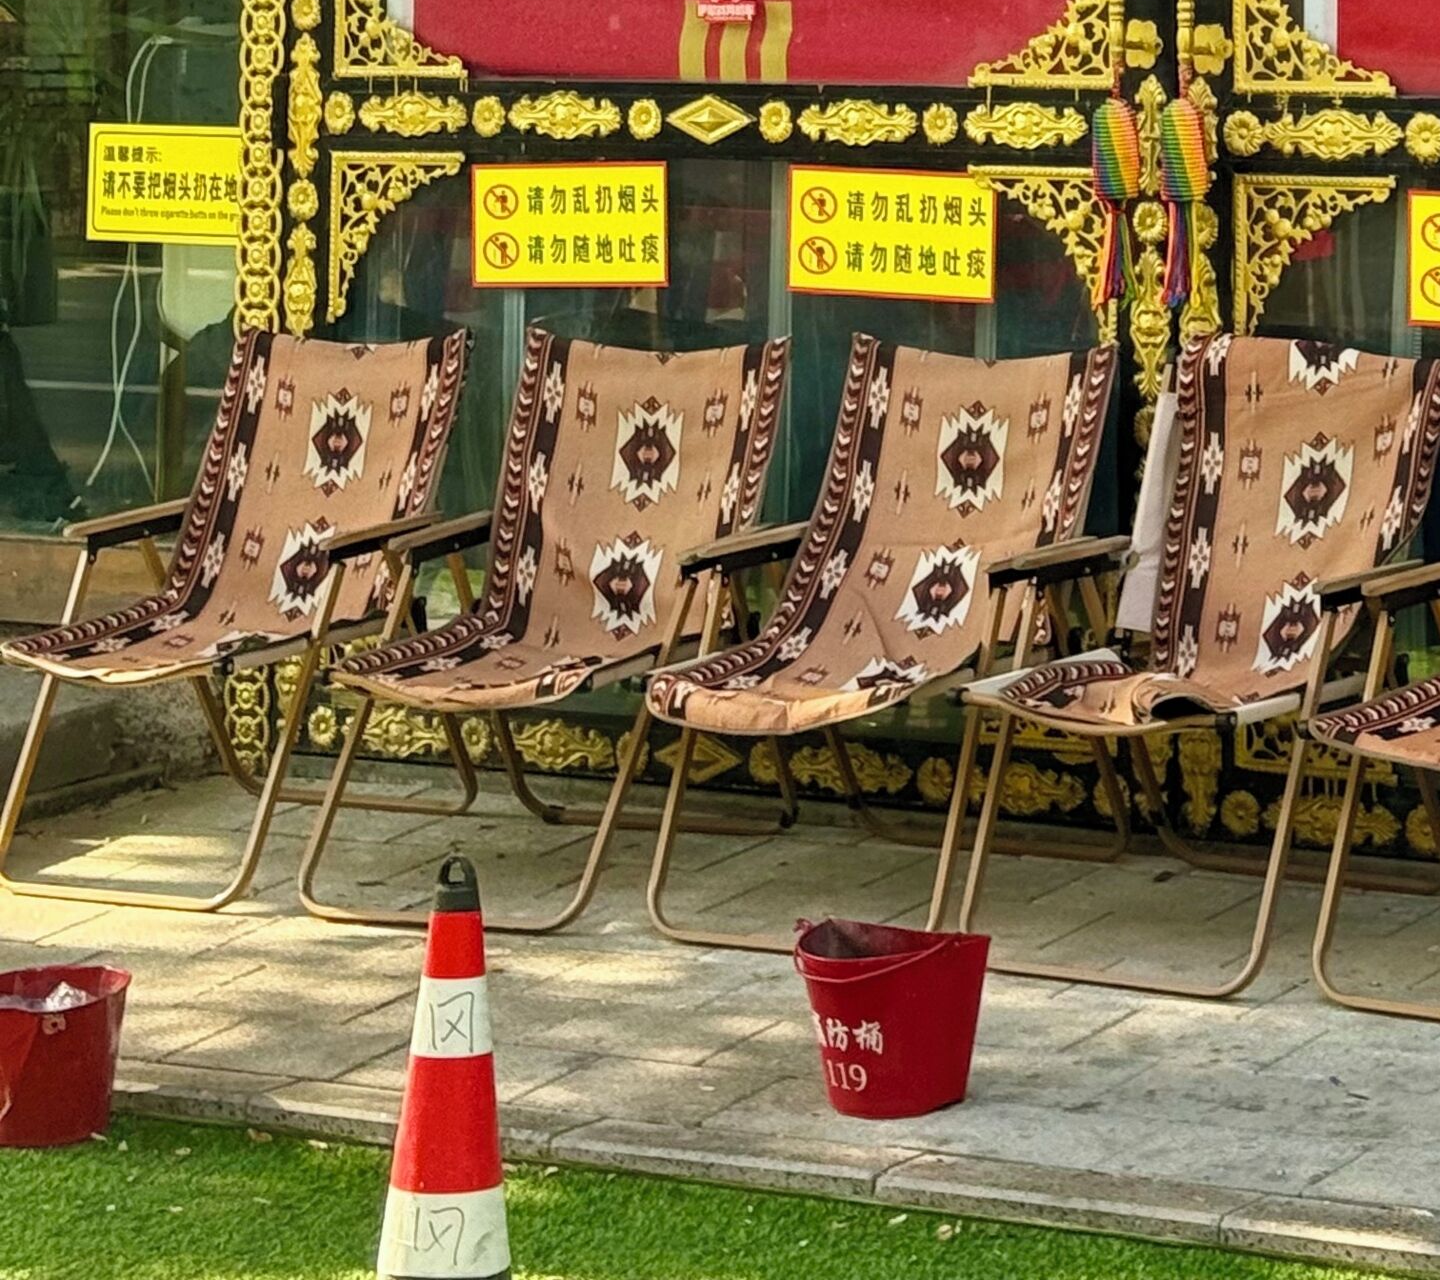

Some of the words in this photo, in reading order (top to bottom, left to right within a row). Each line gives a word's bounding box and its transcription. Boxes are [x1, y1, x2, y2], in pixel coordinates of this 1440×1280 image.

[526, 184, 660, 216] 请勿乱扔烟头
[846, 190, 987, 227] 请勿乱扔烟头
[527, 233, 660, 265] 请勿随地吐痰
[845, 241, 987, 280] 请勿随地吐痰
[826, 1059, 868, 1092] 119
